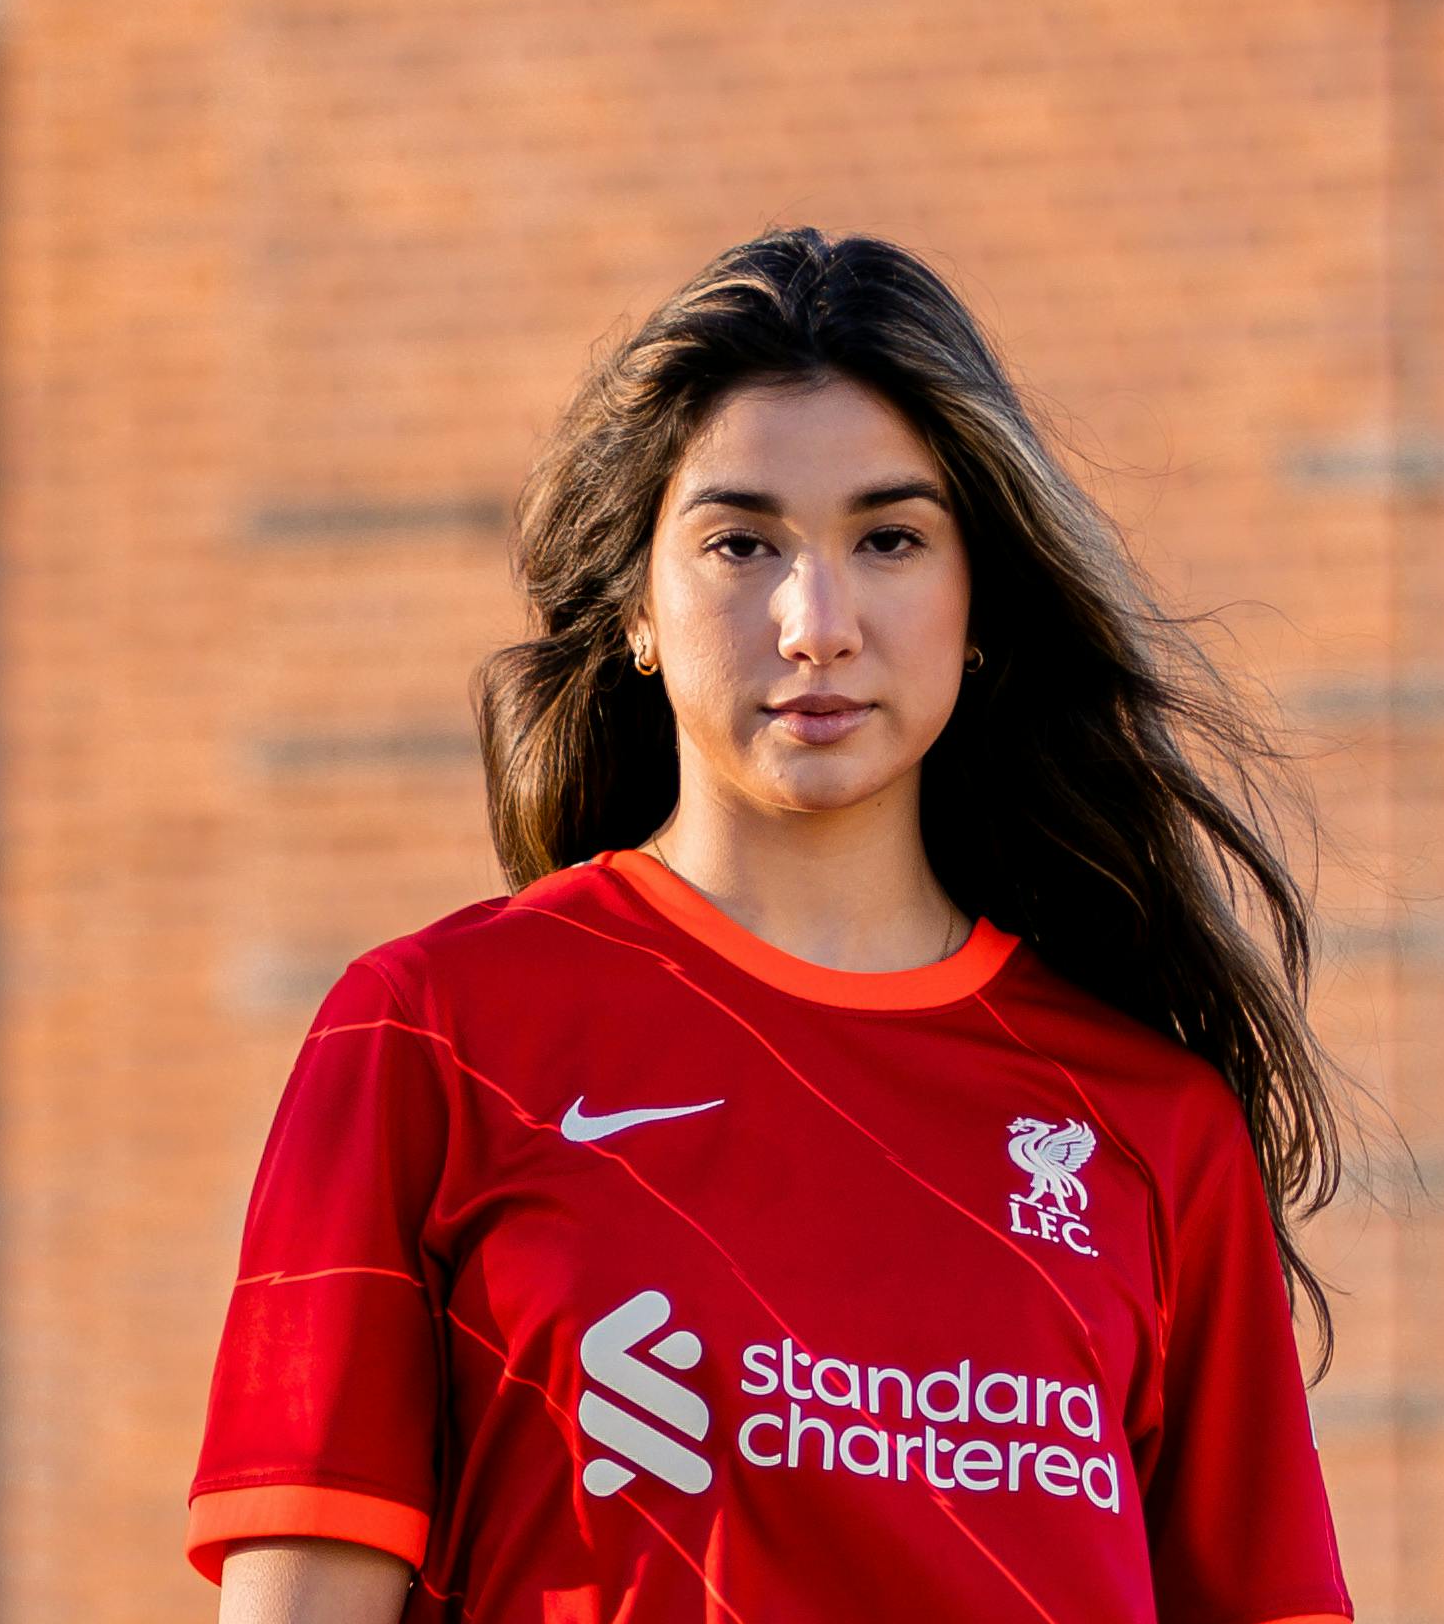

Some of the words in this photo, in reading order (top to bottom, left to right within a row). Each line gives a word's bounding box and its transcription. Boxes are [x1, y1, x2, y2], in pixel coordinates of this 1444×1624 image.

[1008, 1201, 1099, 1258] L.F.C.
[739, 1336, 1102, 1443] standard
[737, 1401, 1121, 1515] chartered
